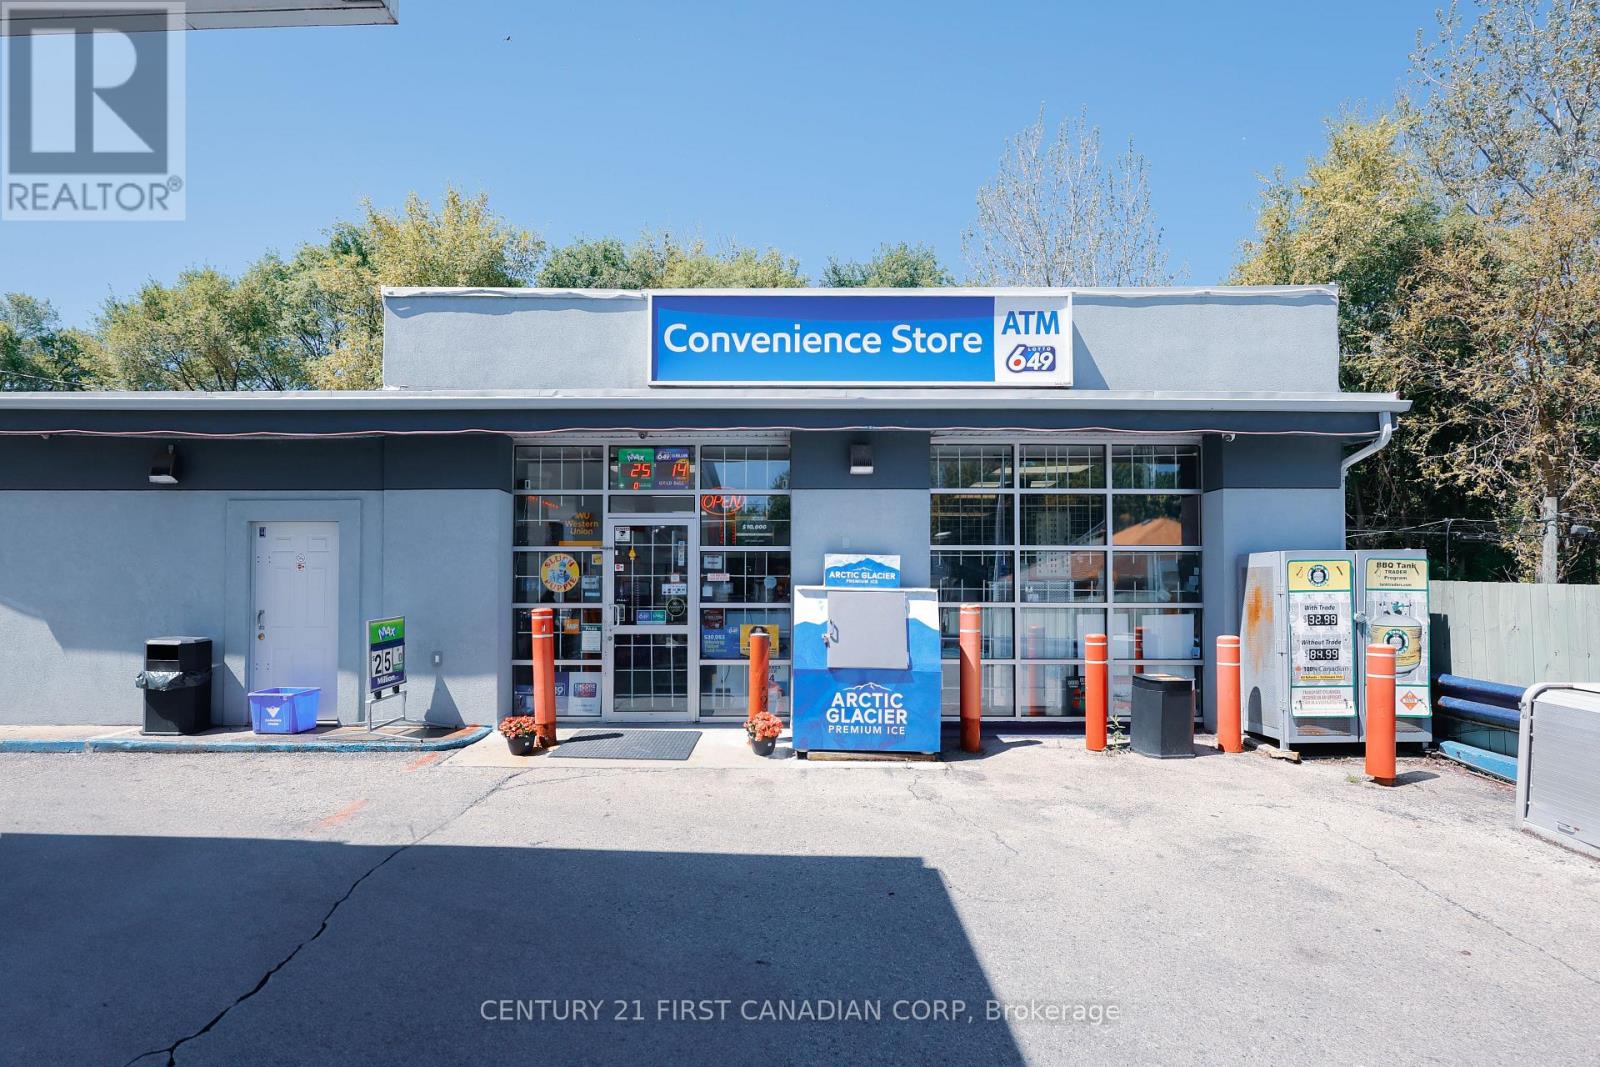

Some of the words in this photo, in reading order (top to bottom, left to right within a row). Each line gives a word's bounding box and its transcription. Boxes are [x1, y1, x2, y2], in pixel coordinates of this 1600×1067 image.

[1001, 310, 1060, 335] ATM
[663, 323, 882, 354] Convenience
[891, 325, 983, 354] Store
[1006, 344, 1054, 373] 649
[630, 463, 652, 478] 25
[672, 462, 688, 478] 14
[703, 495, 743, 509] OPEN
[565, 520, 599, 528] Western
[570, 528, 593, 536] Union
[861, 572, 896, 580] GLACIER
[831, 692, 904, 709] ARCTIC
[826, 708, 908, 725] GLACIER
[828, 726, 882, 734] PREMIUM
[887, 727, 905, 735] ICE
